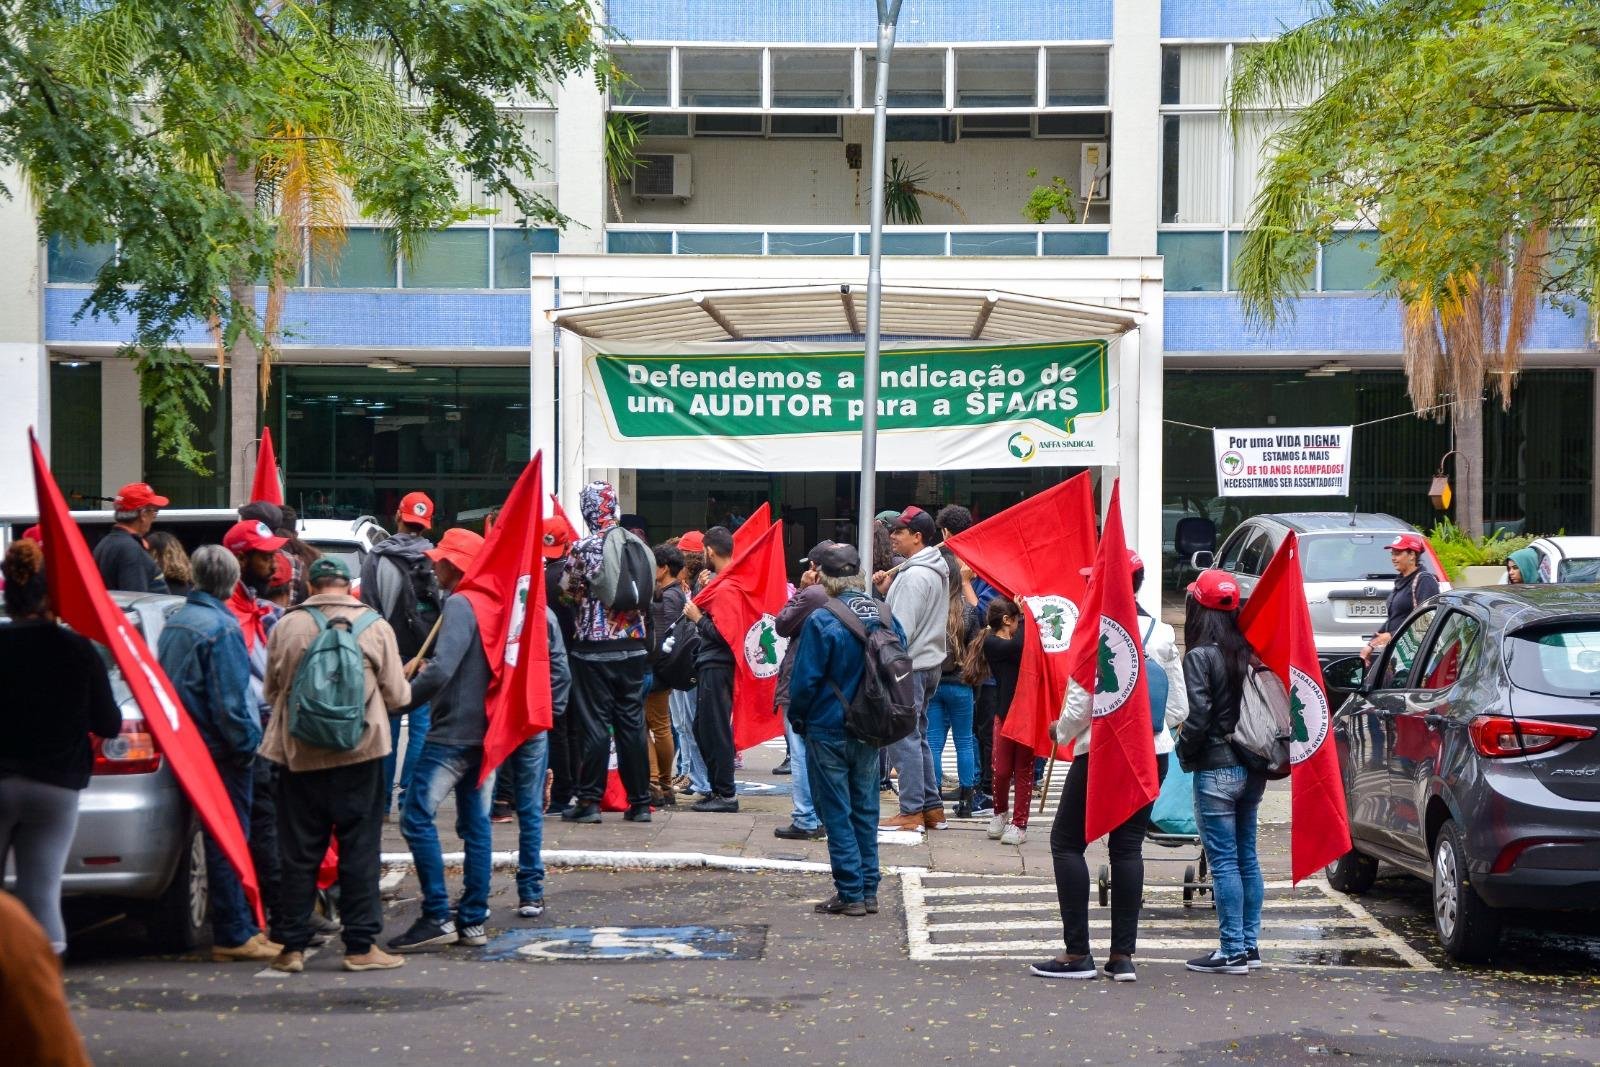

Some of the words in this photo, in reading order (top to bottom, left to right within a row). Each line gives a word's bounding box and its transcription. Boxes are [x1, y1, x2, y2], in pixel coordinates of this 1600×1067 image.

[627, 363, 822, 389] Defendemos
[837, 371, 856, 389] a
[879, 363, 1026, 392] ndicação
[1040, 362, 1078, 385] de
[627, 395, 674, 414] um
[688, 393, 833, 417] AUDITOR
[932, 397, 951, 416] a
[965, 386, 1079, 416] SFA/RS
[1062, 440, 1095, 449] SINDICAL
[1229, 436, 1248, 449] Por
[1250, 437, 1274, 448] uma
[1275, 435, 1300, 448] VIDA
[1303, 434, 1341, 448] DIGNA!
[1262, 451, 1300, 462] ESTAMOS
[1301, 451, 1307, 461] A
[1308, 450, 1330, 461] MAIS
[1247, 465, 1257, 475] DE
[1258, 465, 1268, 475] 10
[1269, 465, 1292, 475] ANOS
[1293, 464, 1345, 475] ACAMPADOS!
[1223, 477, 1279, 489] NECESSITAMOS
[1280, 477, 1293, 488] SER
[1293, 476, 1343, 488] ASSENTADOS!!!
[1351, 605, 1387, 615] IPP-218
[1121, 671, 1137, 700] RURAIS
